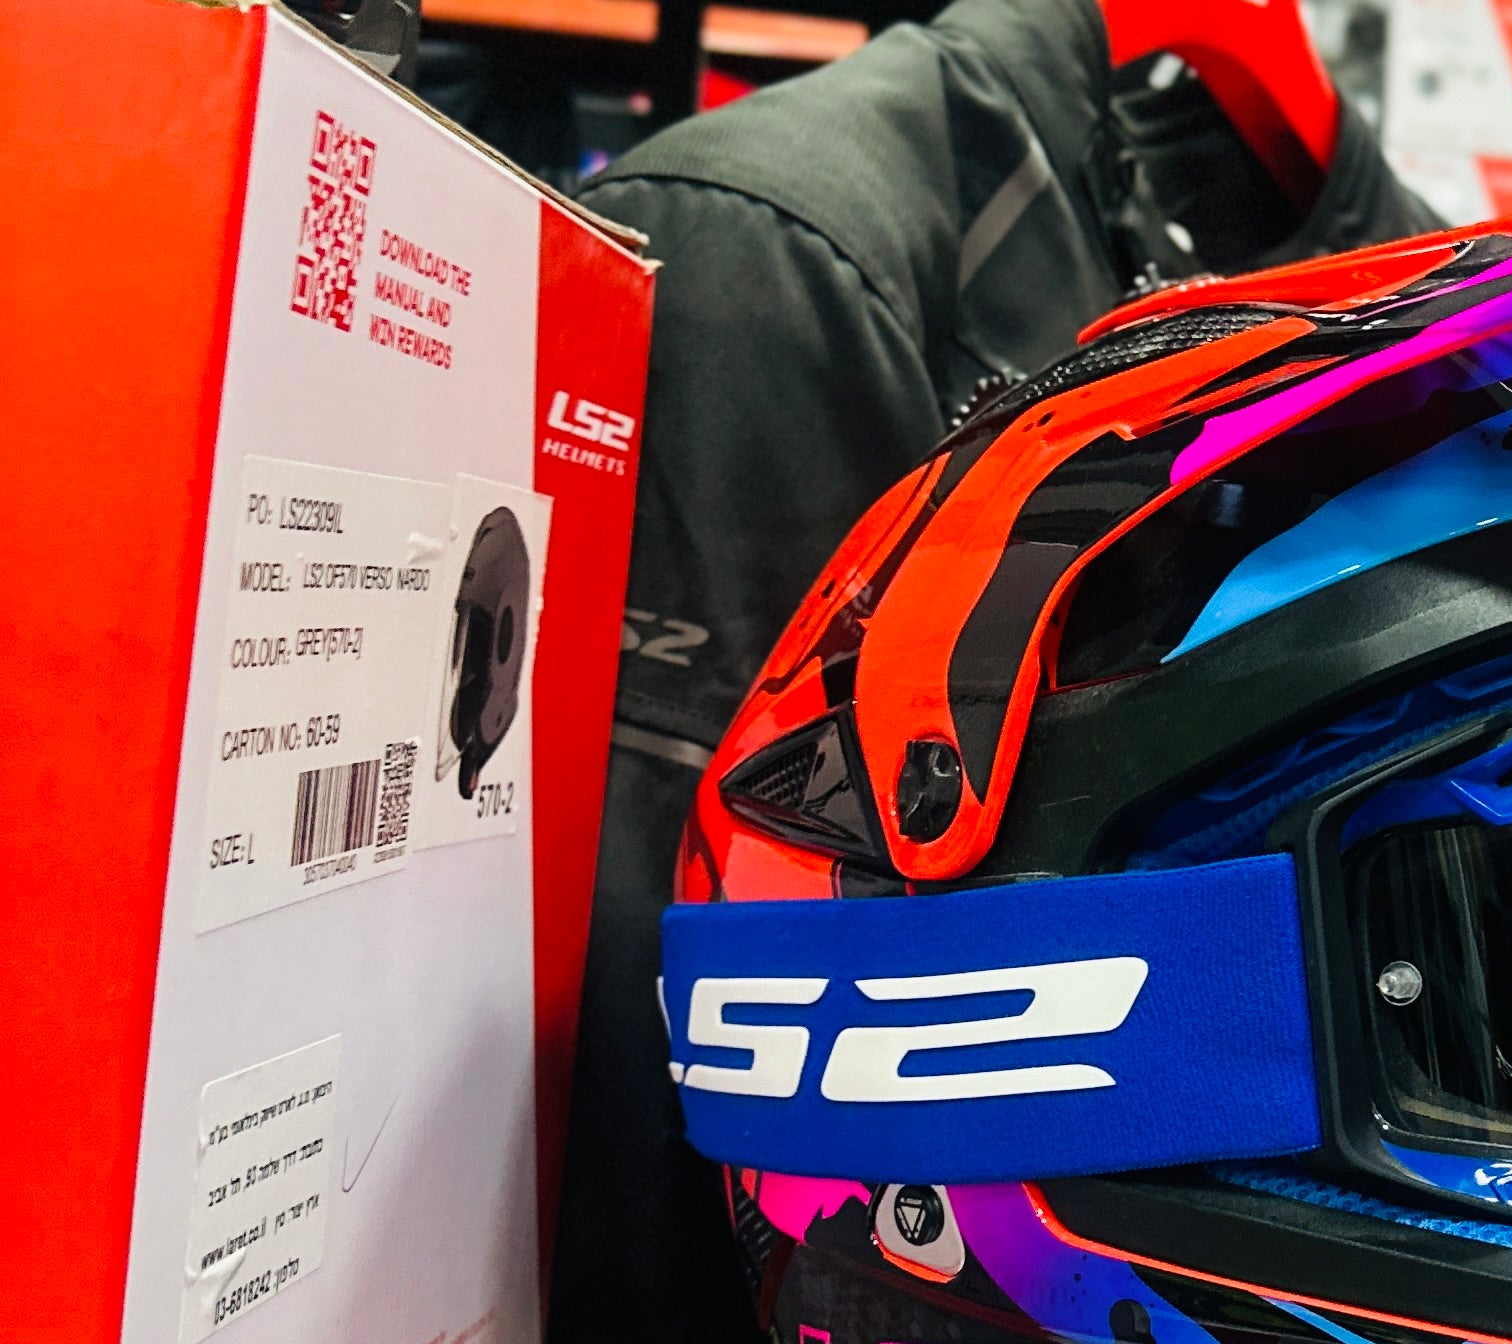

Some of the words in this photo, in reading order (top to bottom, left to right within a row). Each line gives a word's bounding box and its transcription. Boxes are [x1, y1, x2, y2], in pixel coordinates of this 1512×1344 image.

[380, 229, 449, 285] DOWNLOAD
[451, 264, 472, 297] THE
[374, 271, 425, 318] MANUAL
[426, 296, 453, 328] AND
[369, 313, 396, 349] WIN
[397, 325, 453, 370] REWARDS
[547, 390, 636, 453] LS2
[541, 437, 627, 477] HELMETS
[247, 493, 273, 525] PO:
[239, 561, 292, 592] MODEL:
[303, 562, 323, 588] LS2
[360, 564, 393, 591] VERSO
[397, 566, 431, 592] NARDO
[231, 637, 292, 669] COLOUR:
[221, 723, 277, 762] CARTON
[279, 722, 302, 752] NO:
[306, 713, 341, 748] 60-59
[477, 781, 514, 819] 570-2
[247, 832, 255, 865] L
[214, 1269, 271, 1326] 03-6818242
